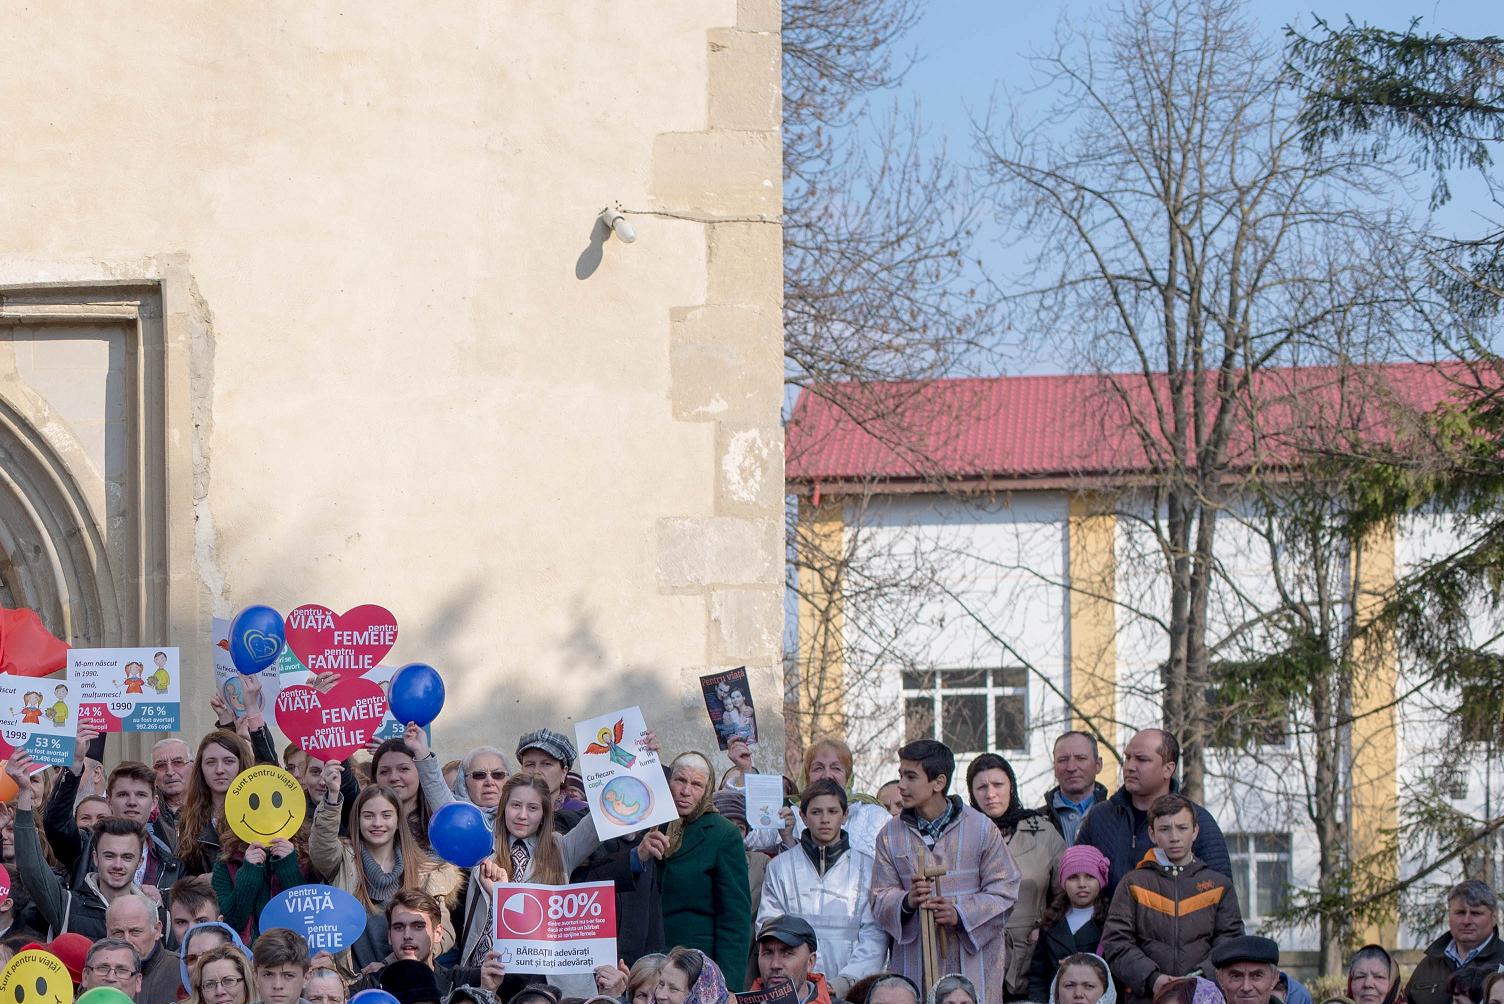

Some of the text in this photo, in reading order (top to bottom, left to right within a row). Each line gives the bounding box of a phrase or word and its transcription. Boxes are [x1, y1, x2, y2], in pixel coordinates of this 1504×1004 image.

[293, 608, 322, 617] pentru
[290, 612, 335, 632] VIAȚĂ
[368, 624, 398, 633] pentru
[334, 631, 394, 645] FEMEIE
[324, 648, 354, 657] pentru
[308, 655, 373, 669] FAMILIE
[280, 688, 308, 699] pentru
[111, 702, 132, 710] 1990
[277, 691, 322, 713] VIAȚĂ
[355, 695, 386, 707] pentru
[79, 706, 102, 716] 24 %
[141, 706, 166, 716] 76 %
[321, 703, 384, 724] FEMEIE
[315, 726, 345, 737] pentru
[392, 724, 405, 733] 53
[5, 731, 27, 740] 1998
[300, 730, 366, 751] FAMILIE
[35, 737, 61, 749] 53 %
[232, 769, 298, 796] Sunt pentru viață!
[288, 888, 317, 898] pentru
[285, 891, 334, 914] VIAȚĂ
[548, 891, 602, 919] 80%
[308, 924, 338, 934] pentru
[516, 946, 590, 957] BĂRBAȚII adevărați
[535, 959, 541, 967] și
[543, 959, 556, 968] tați
[557, 957, 593, 967] adevărați
[0, 955, 61, 992] Sunt pentru viață!
